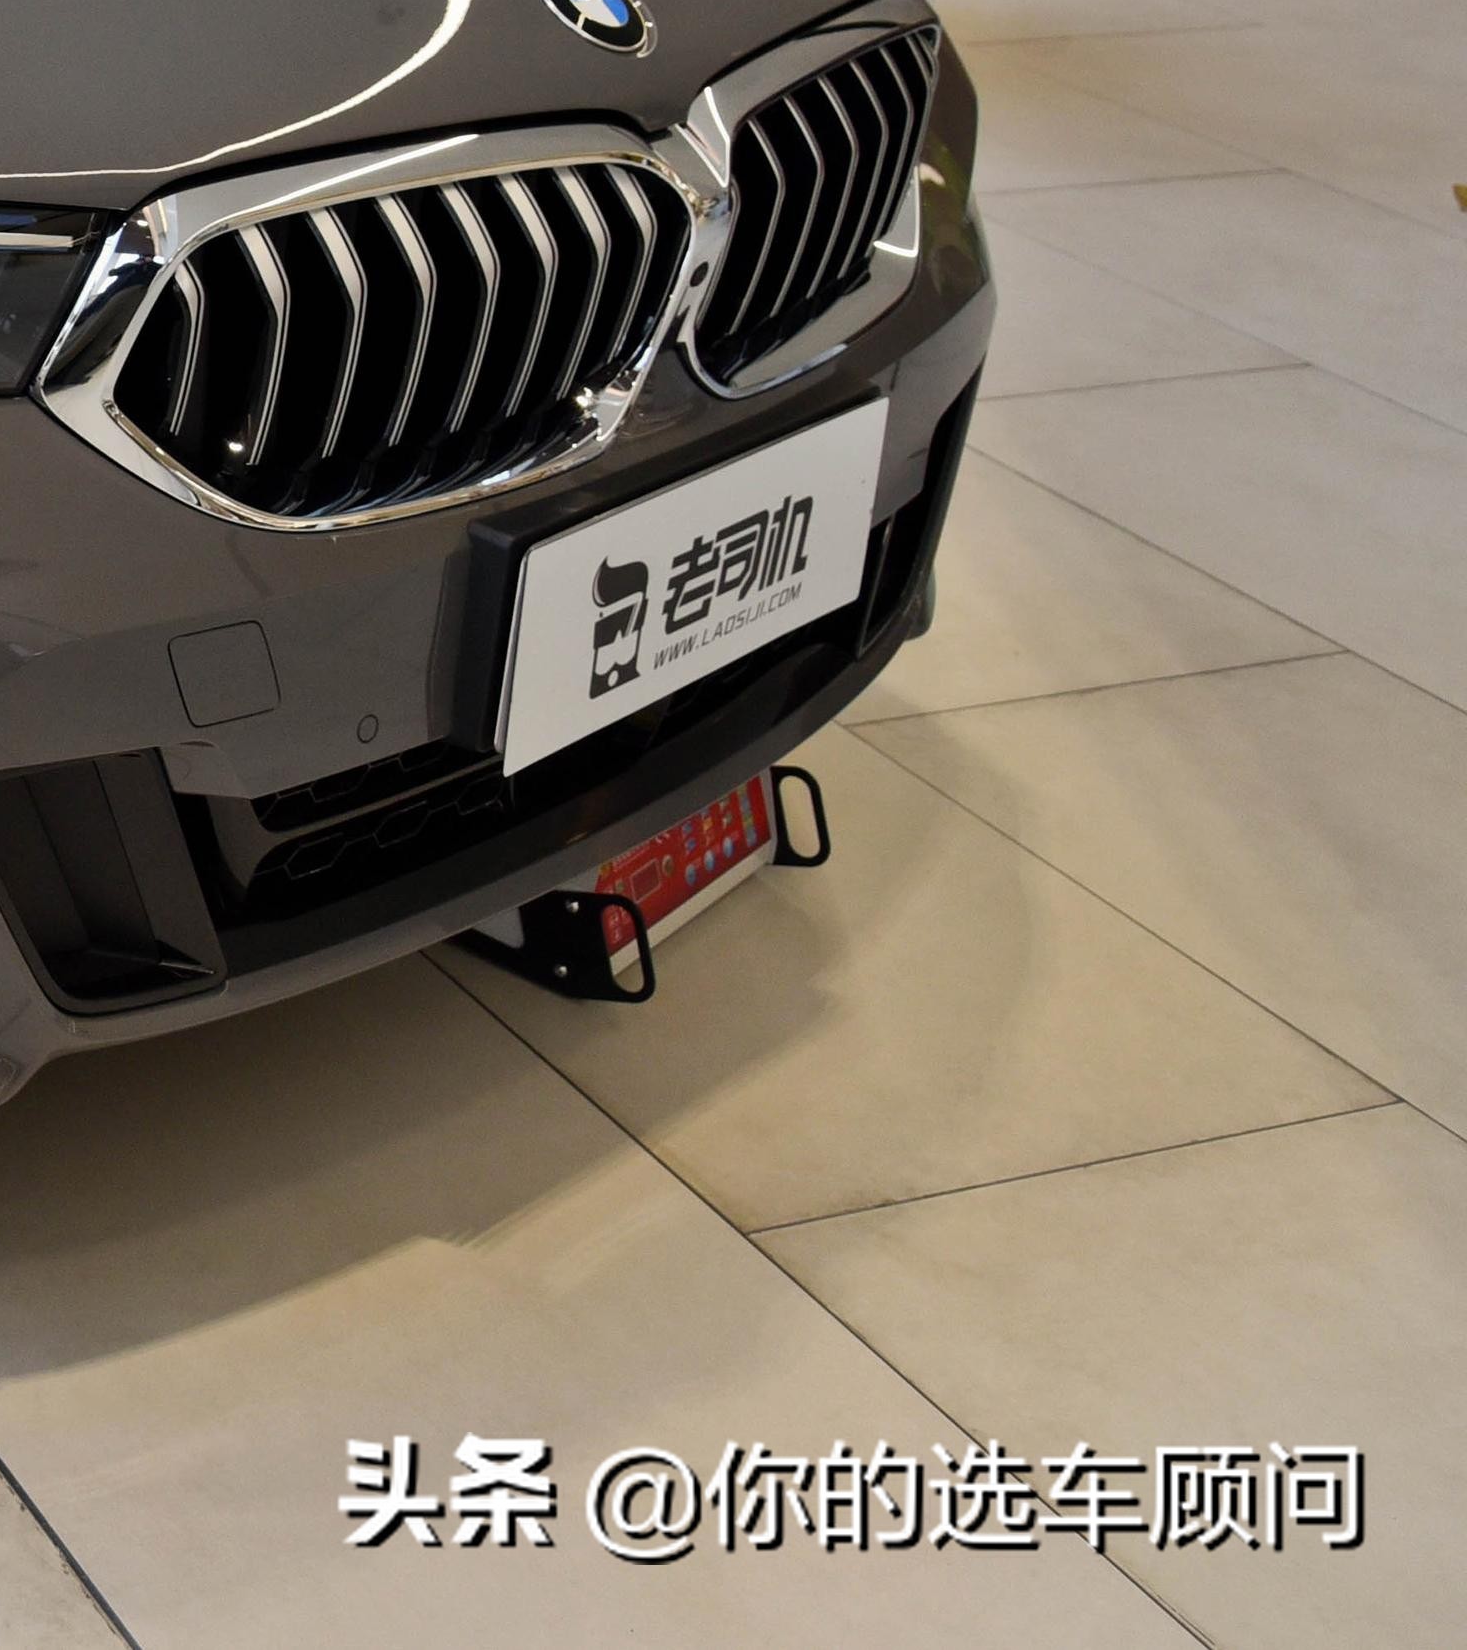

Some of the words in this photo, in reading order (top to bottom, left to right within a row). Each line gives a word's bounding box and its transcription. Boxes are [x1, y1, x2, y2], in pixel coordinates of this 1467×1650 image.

[662, 496, 813, 635] 老司机
[654, 582, 803, 670] WWW.LAOSIJI.COM
